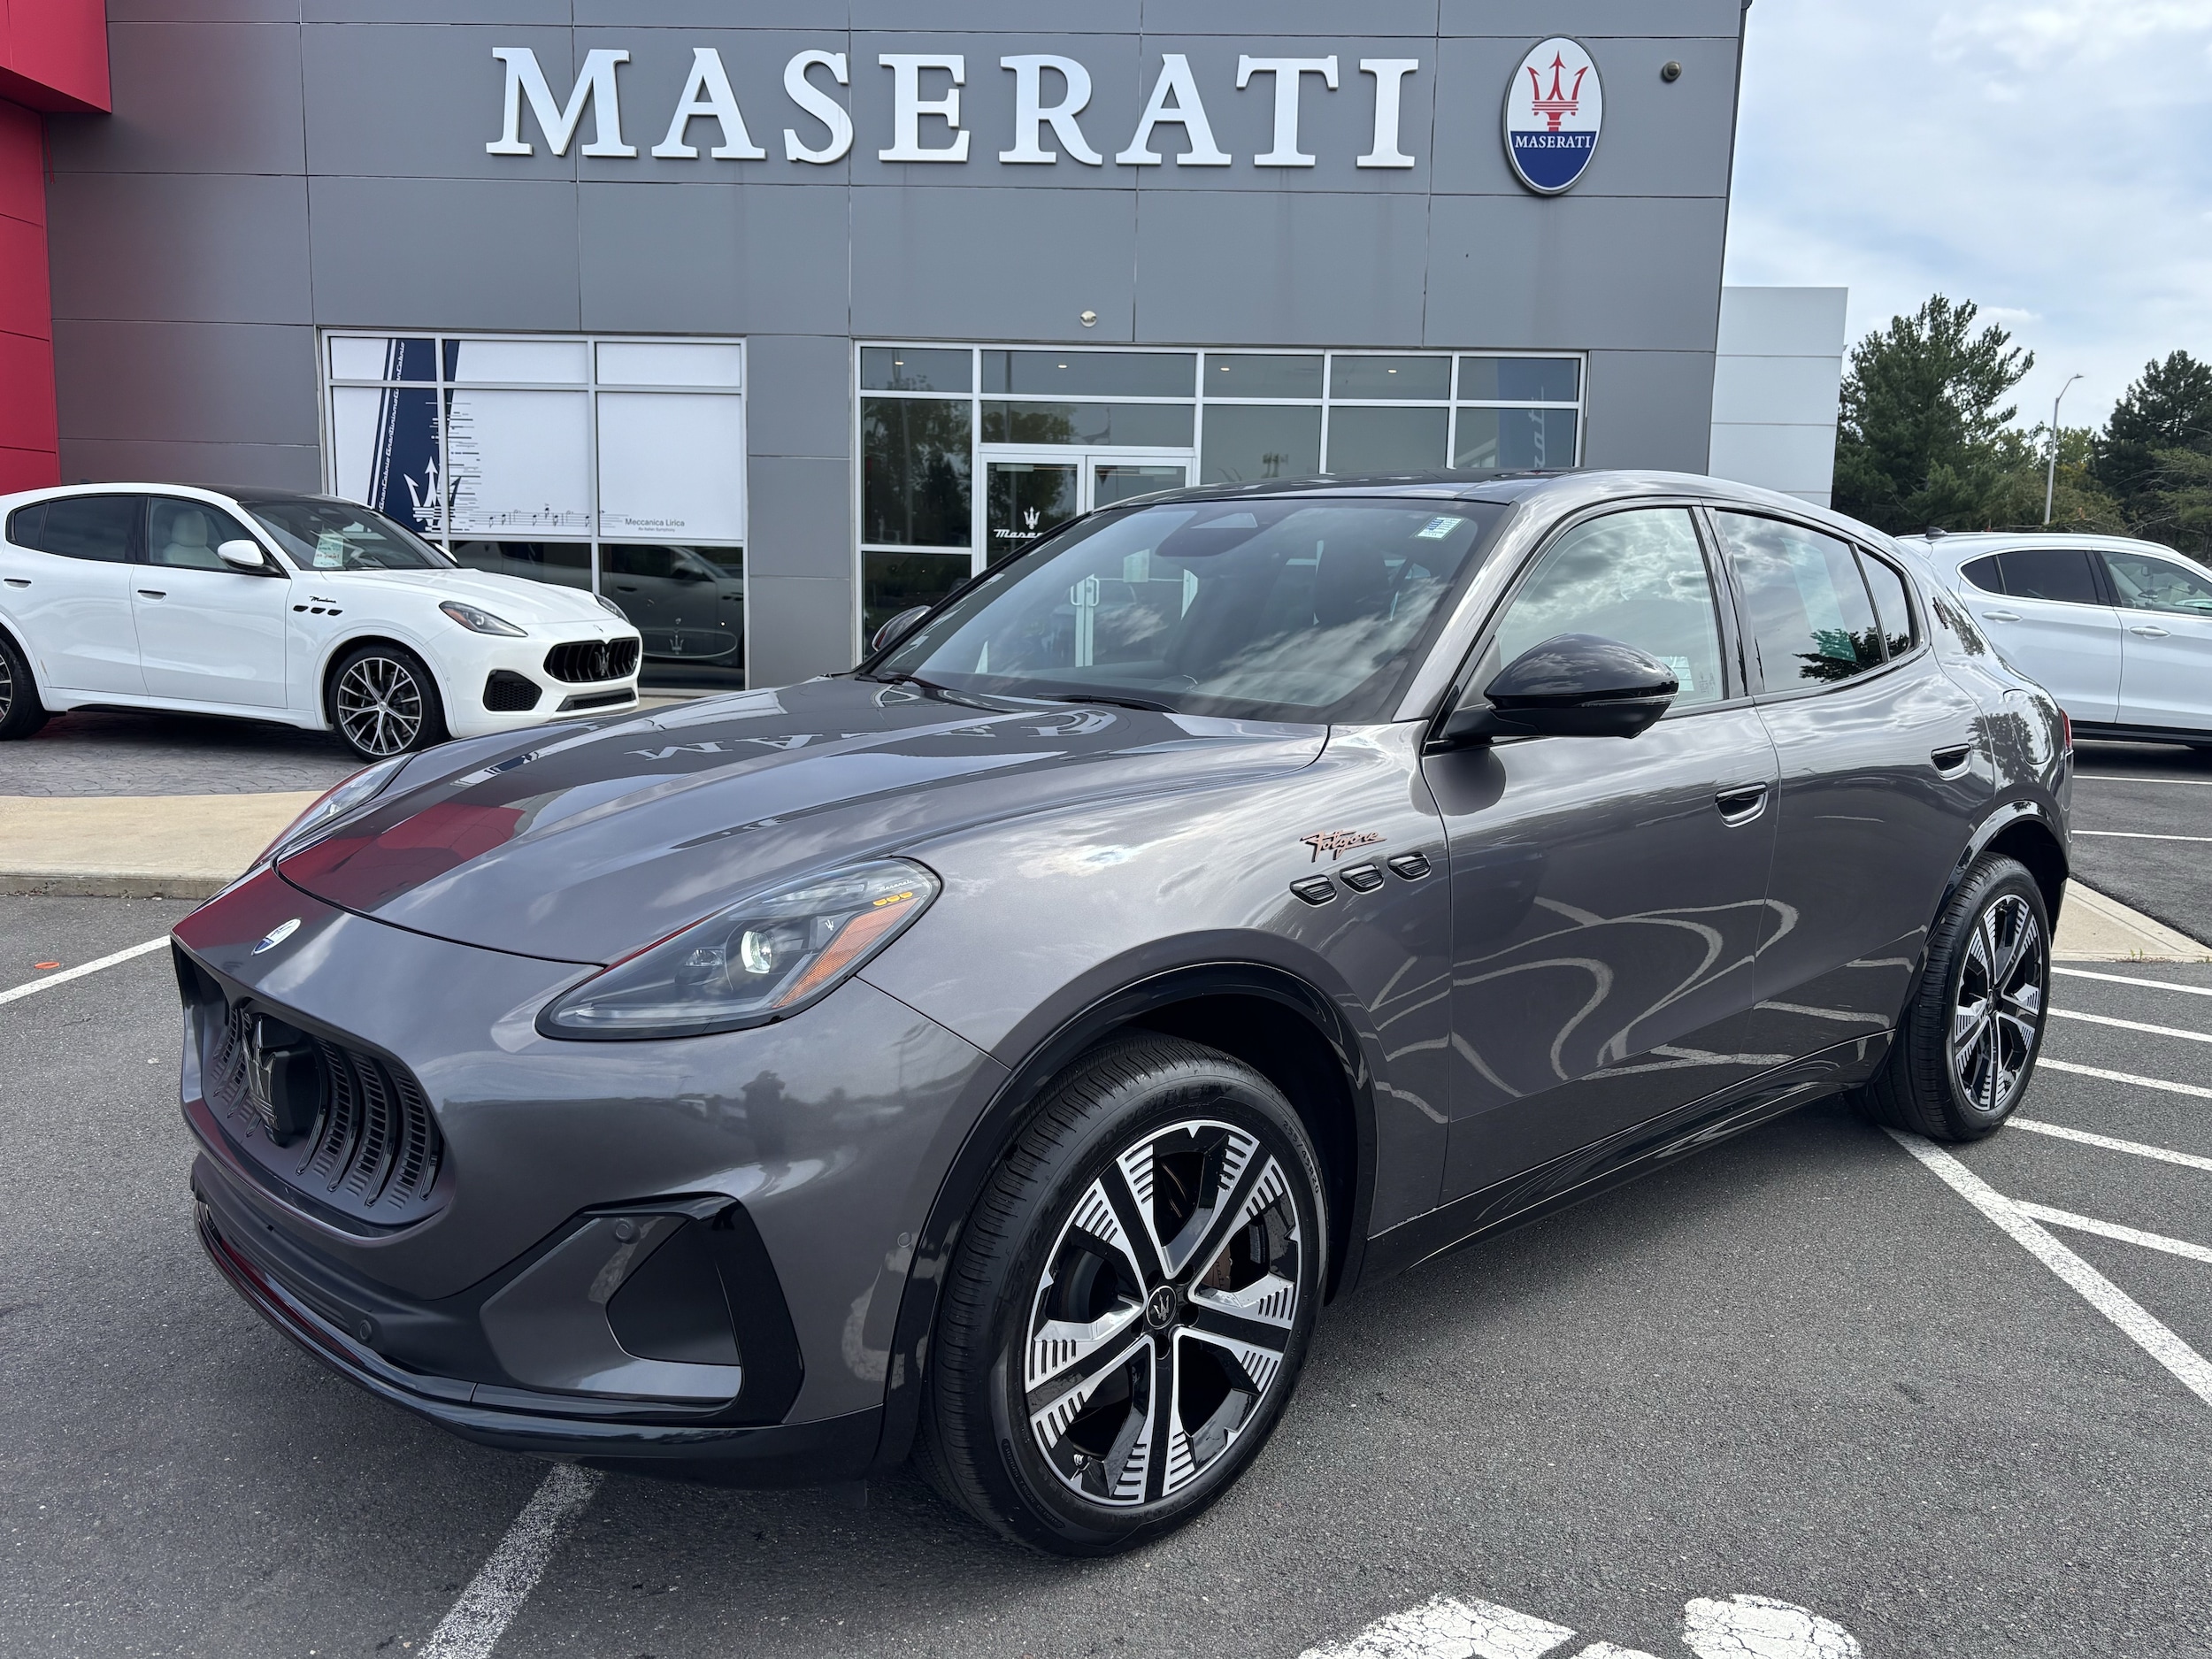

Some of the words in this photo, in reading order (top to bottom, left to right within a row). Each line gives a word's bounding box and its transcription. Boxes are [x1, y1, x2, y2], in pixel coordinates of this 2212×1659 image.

[486, 47, 1419, 167] MASERATI
[1515, 135, 1592, 150] MASERATI
[625, 518, 664, 526] Meccanica
[665, 518, 685, 527] Lirica
[1299, 829, 1388, 864] Folgore
